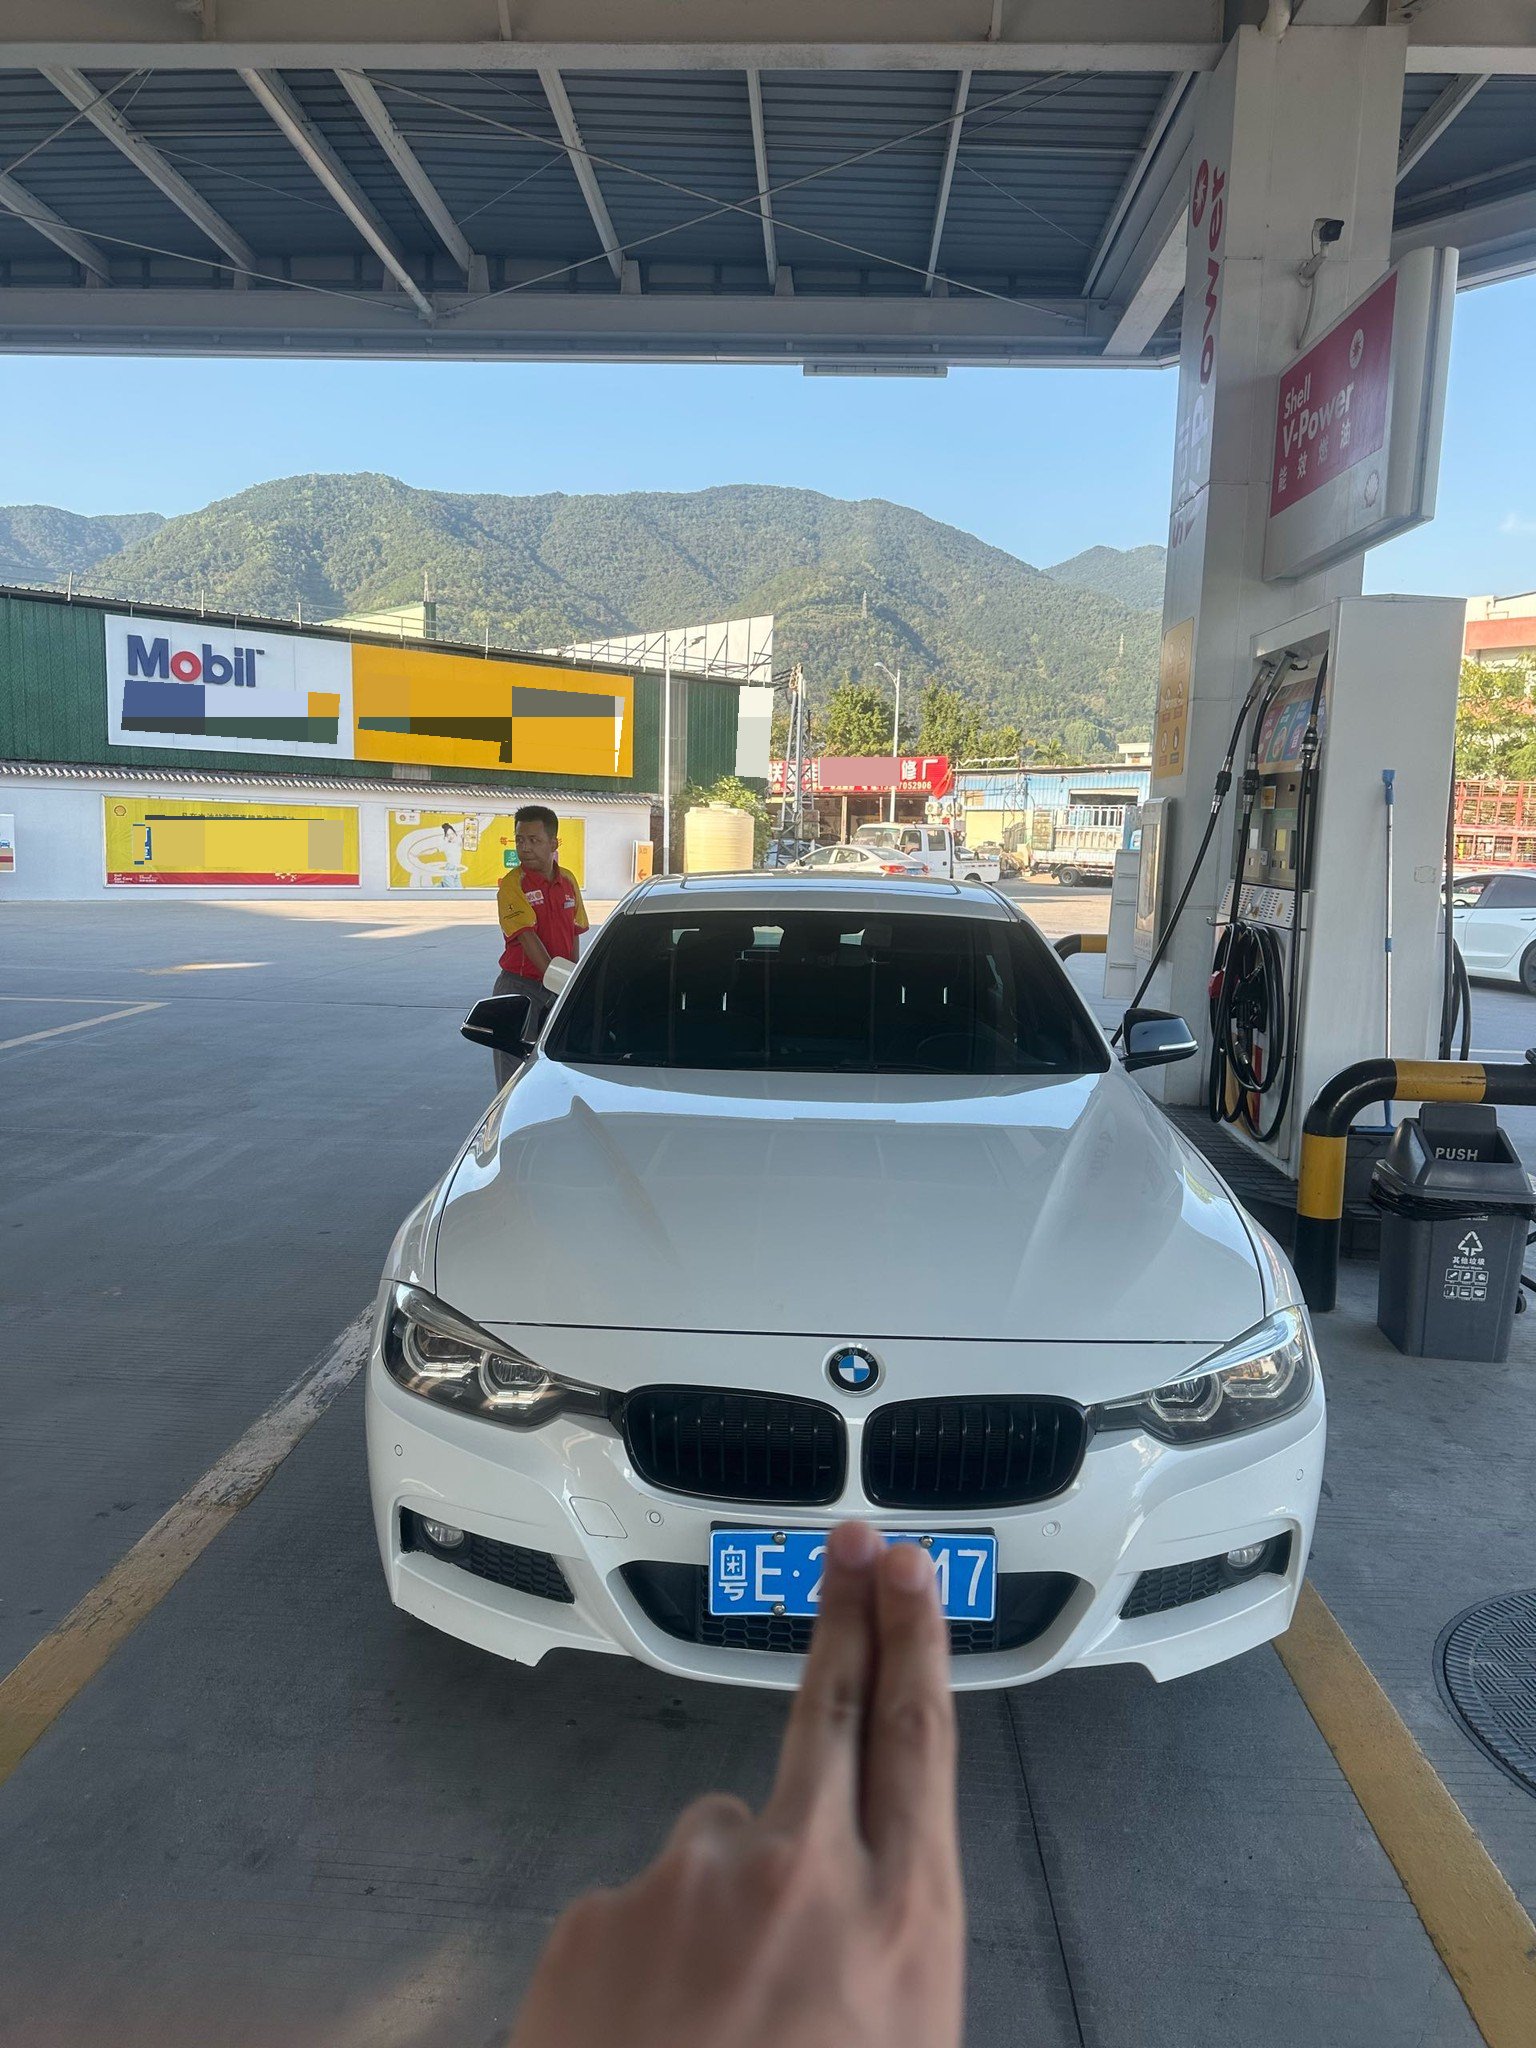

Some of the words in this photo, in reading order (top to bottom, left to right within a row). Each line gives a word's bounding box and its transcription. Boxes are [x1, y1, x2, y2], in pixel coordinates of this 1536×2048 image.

[1185, 165, 1225, 541] V-Power
[1283, 382, 1354, 458] V-Power
[1284, 373, 1311, 419] Shell
[1278, 418, 1351, 493] 能效燃油
[127, 634, 256, 687] Mobil
[1435, 1147, 1479, 1161] PUSH
[1452, 1256, 1485, 1266] 其他垃圾
[834, 1348, 874, 1362] BMW
